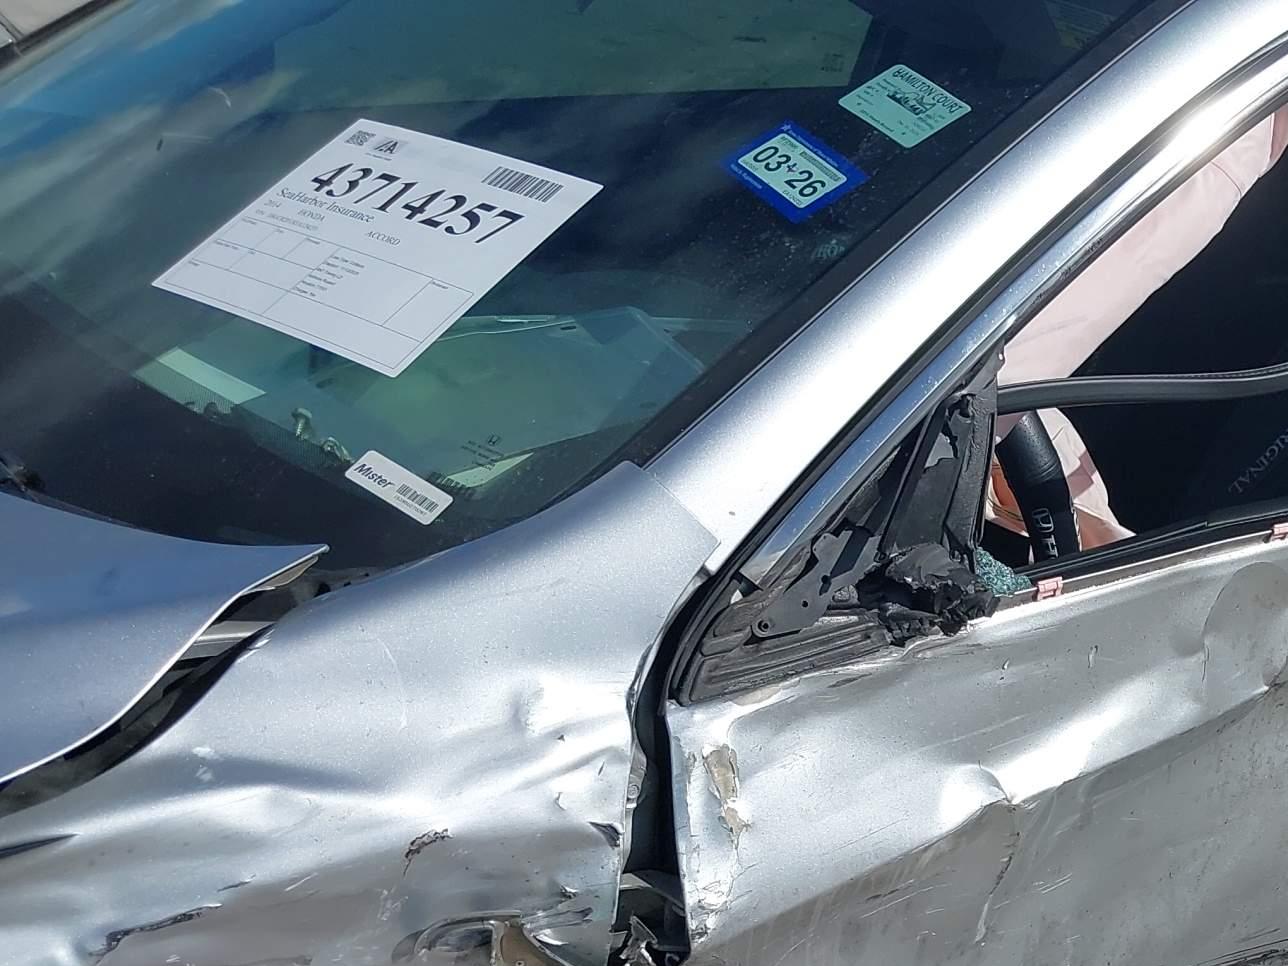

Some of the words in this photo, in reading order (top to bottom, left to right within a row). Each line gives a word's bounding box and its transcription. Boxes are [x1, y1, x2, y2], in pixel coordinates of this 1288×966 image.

[892, 68, 936, 97] HAMILTON
[931, 92, 963, 113] COURT
[752, 145, 791, 172] 03
[783, 169, 827, 198] 26
[277, 187, 328, 208] SeaHarbor
[326, 202, 376, 223] Insurance
[310, 162, 525, 244] 43714257
[297, 208, 326, 222] HONDA
[365, 231, 401, 246] ACCORD
[353, 463, 395, 489] Mister
